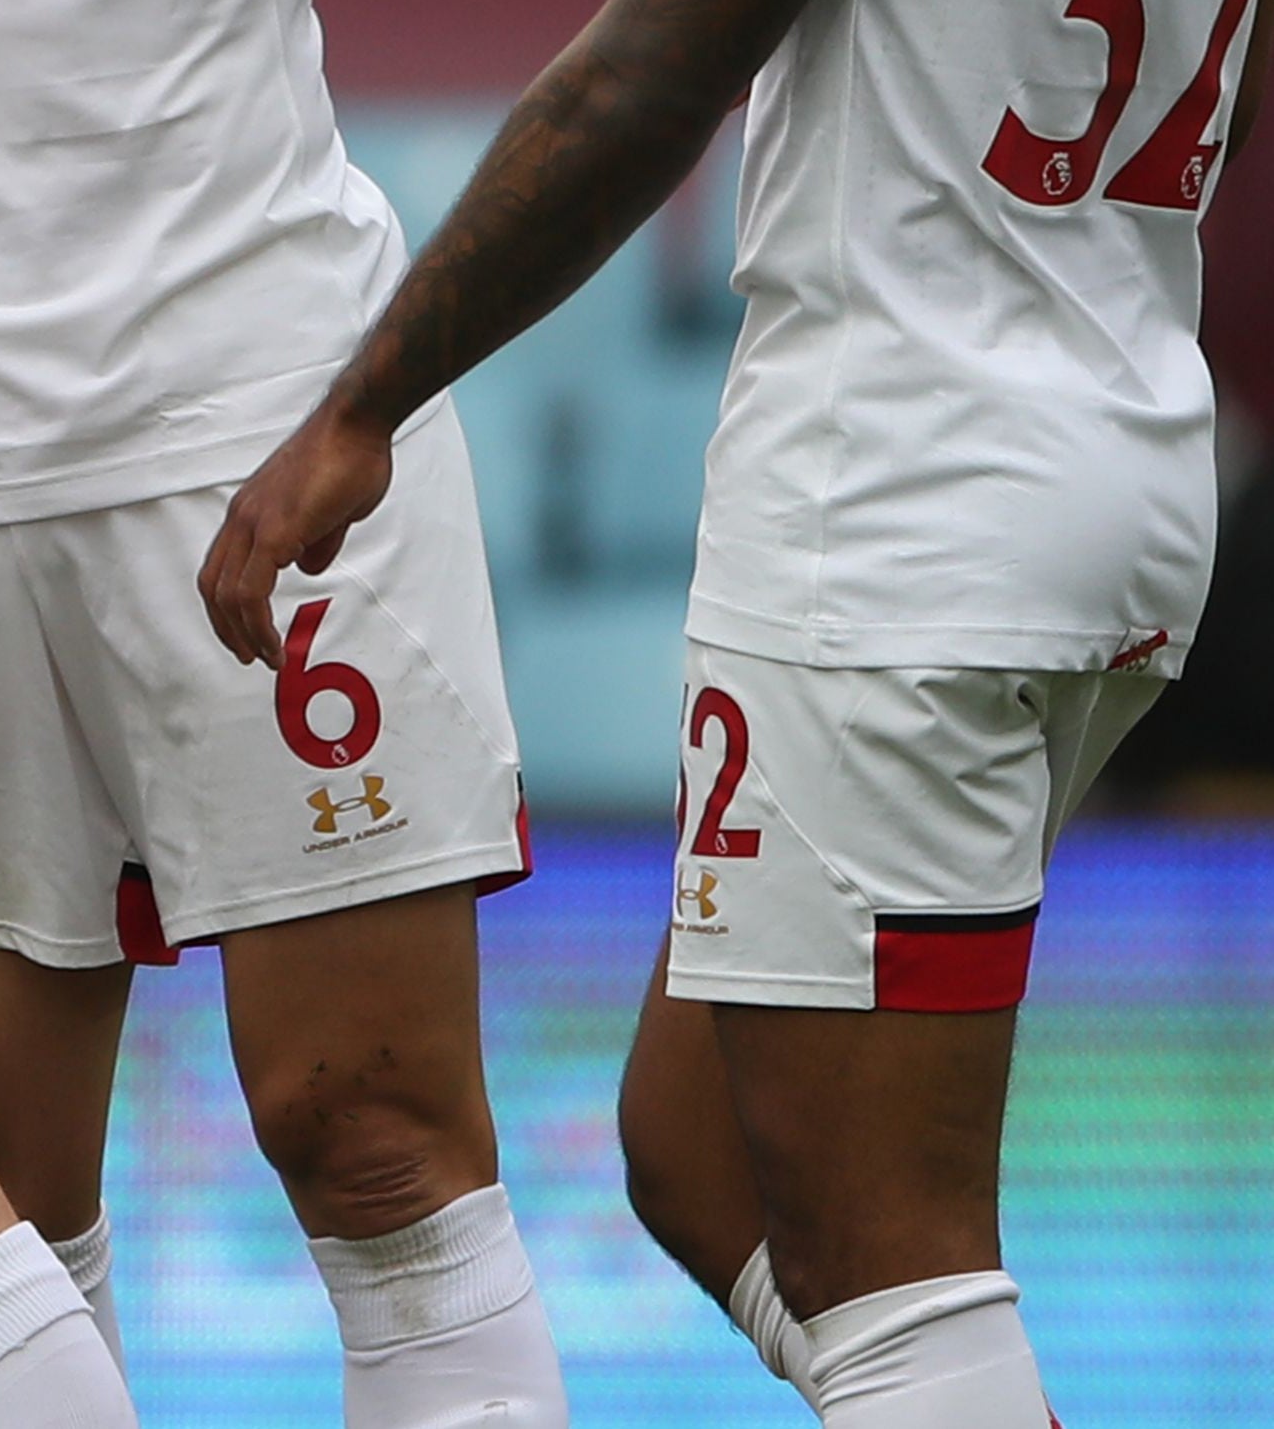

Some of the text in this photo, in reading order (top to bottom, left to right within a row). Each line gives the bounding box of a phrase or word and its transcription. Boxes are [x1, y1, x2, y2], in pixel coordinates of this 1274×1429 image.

[274, 598, 381, 769] 6
[303, 817, 408, 854] UNDER ARMOUR
[677, 683, 761, 858] 2
